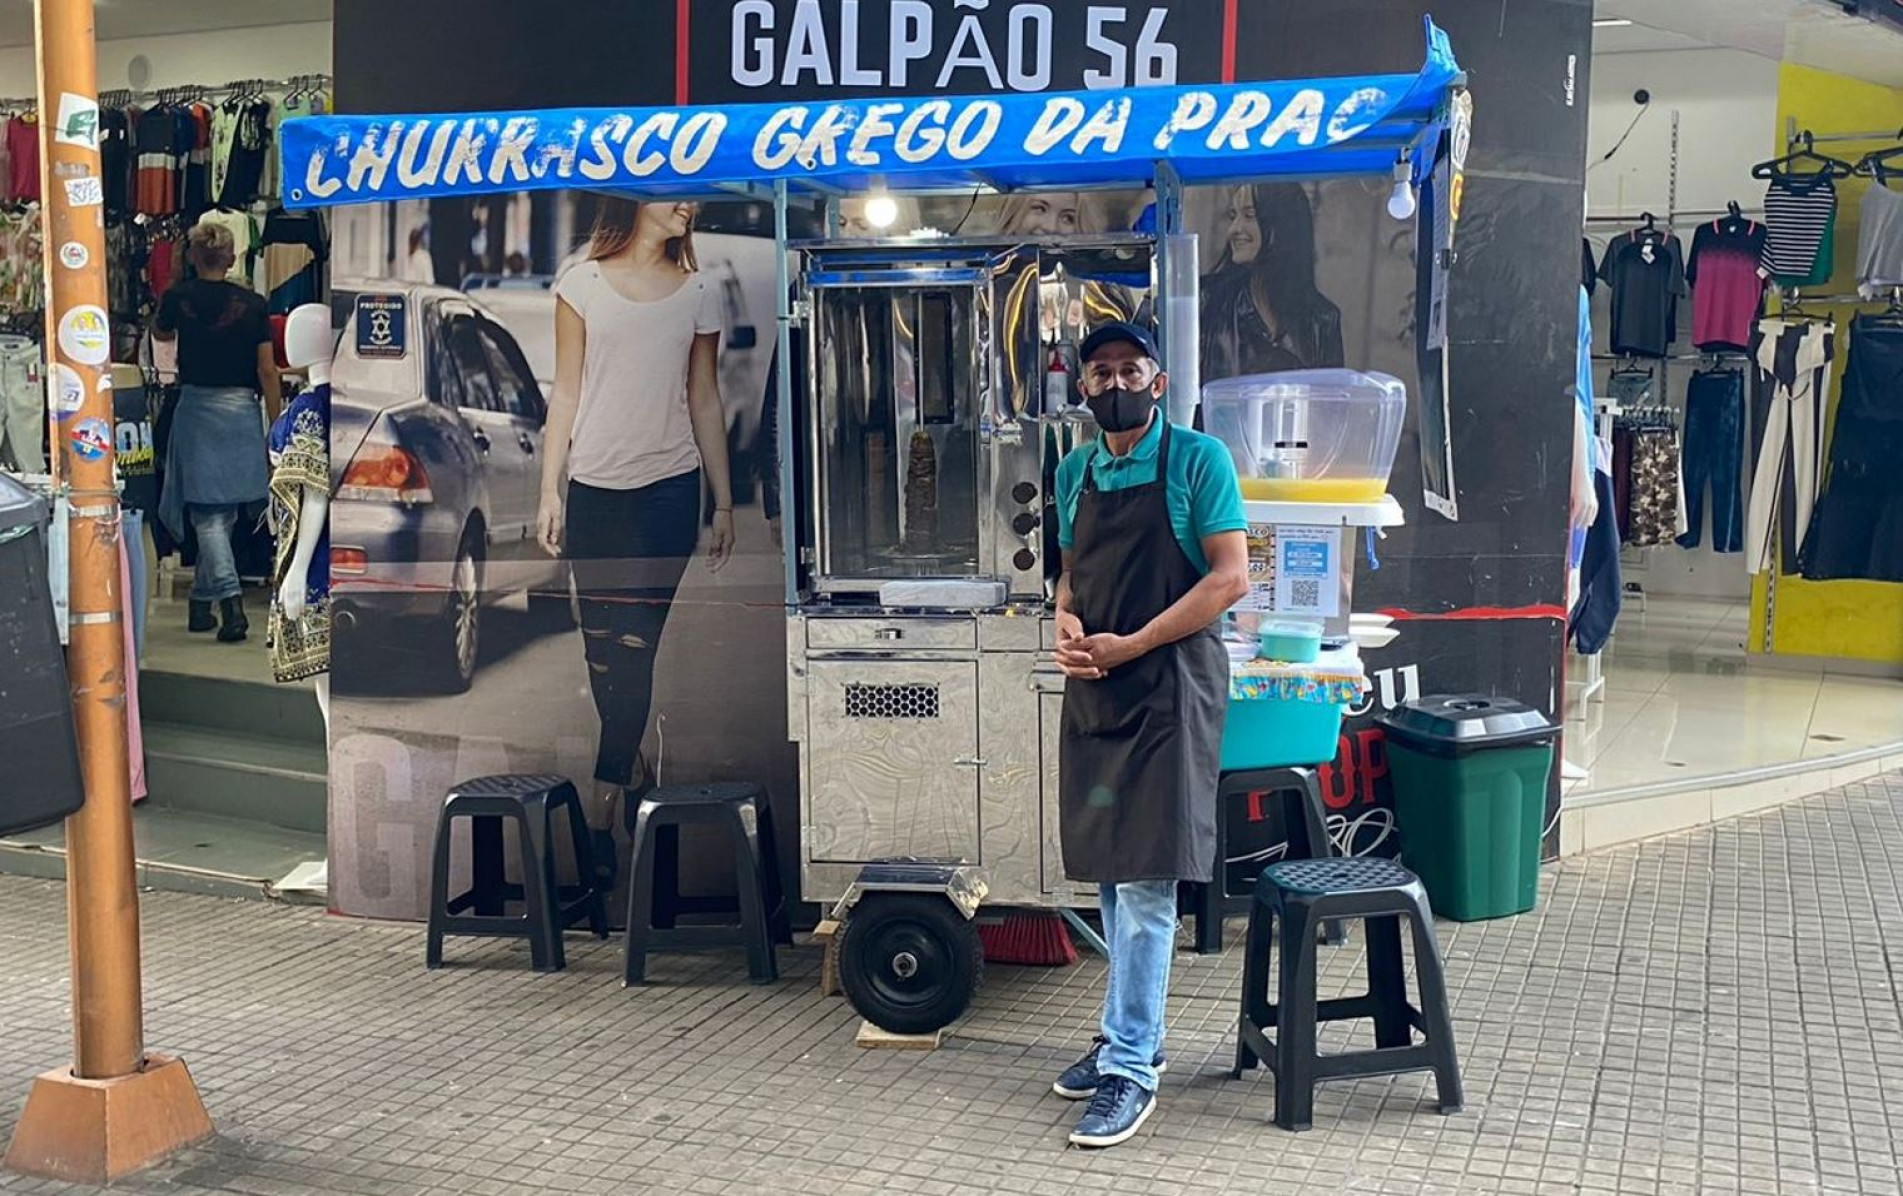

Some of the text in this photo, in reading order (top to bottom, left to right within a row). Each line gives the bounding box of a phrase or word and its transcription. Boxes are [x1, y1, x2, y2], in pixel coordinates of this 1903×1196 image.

[731, 0, 1177, 91] GALPÃO 56
[305, 112, 727, 197] CHURRASCO
[752, 99, 1002, 170] GREGO
[1023, 96, 1132, 156] DA
